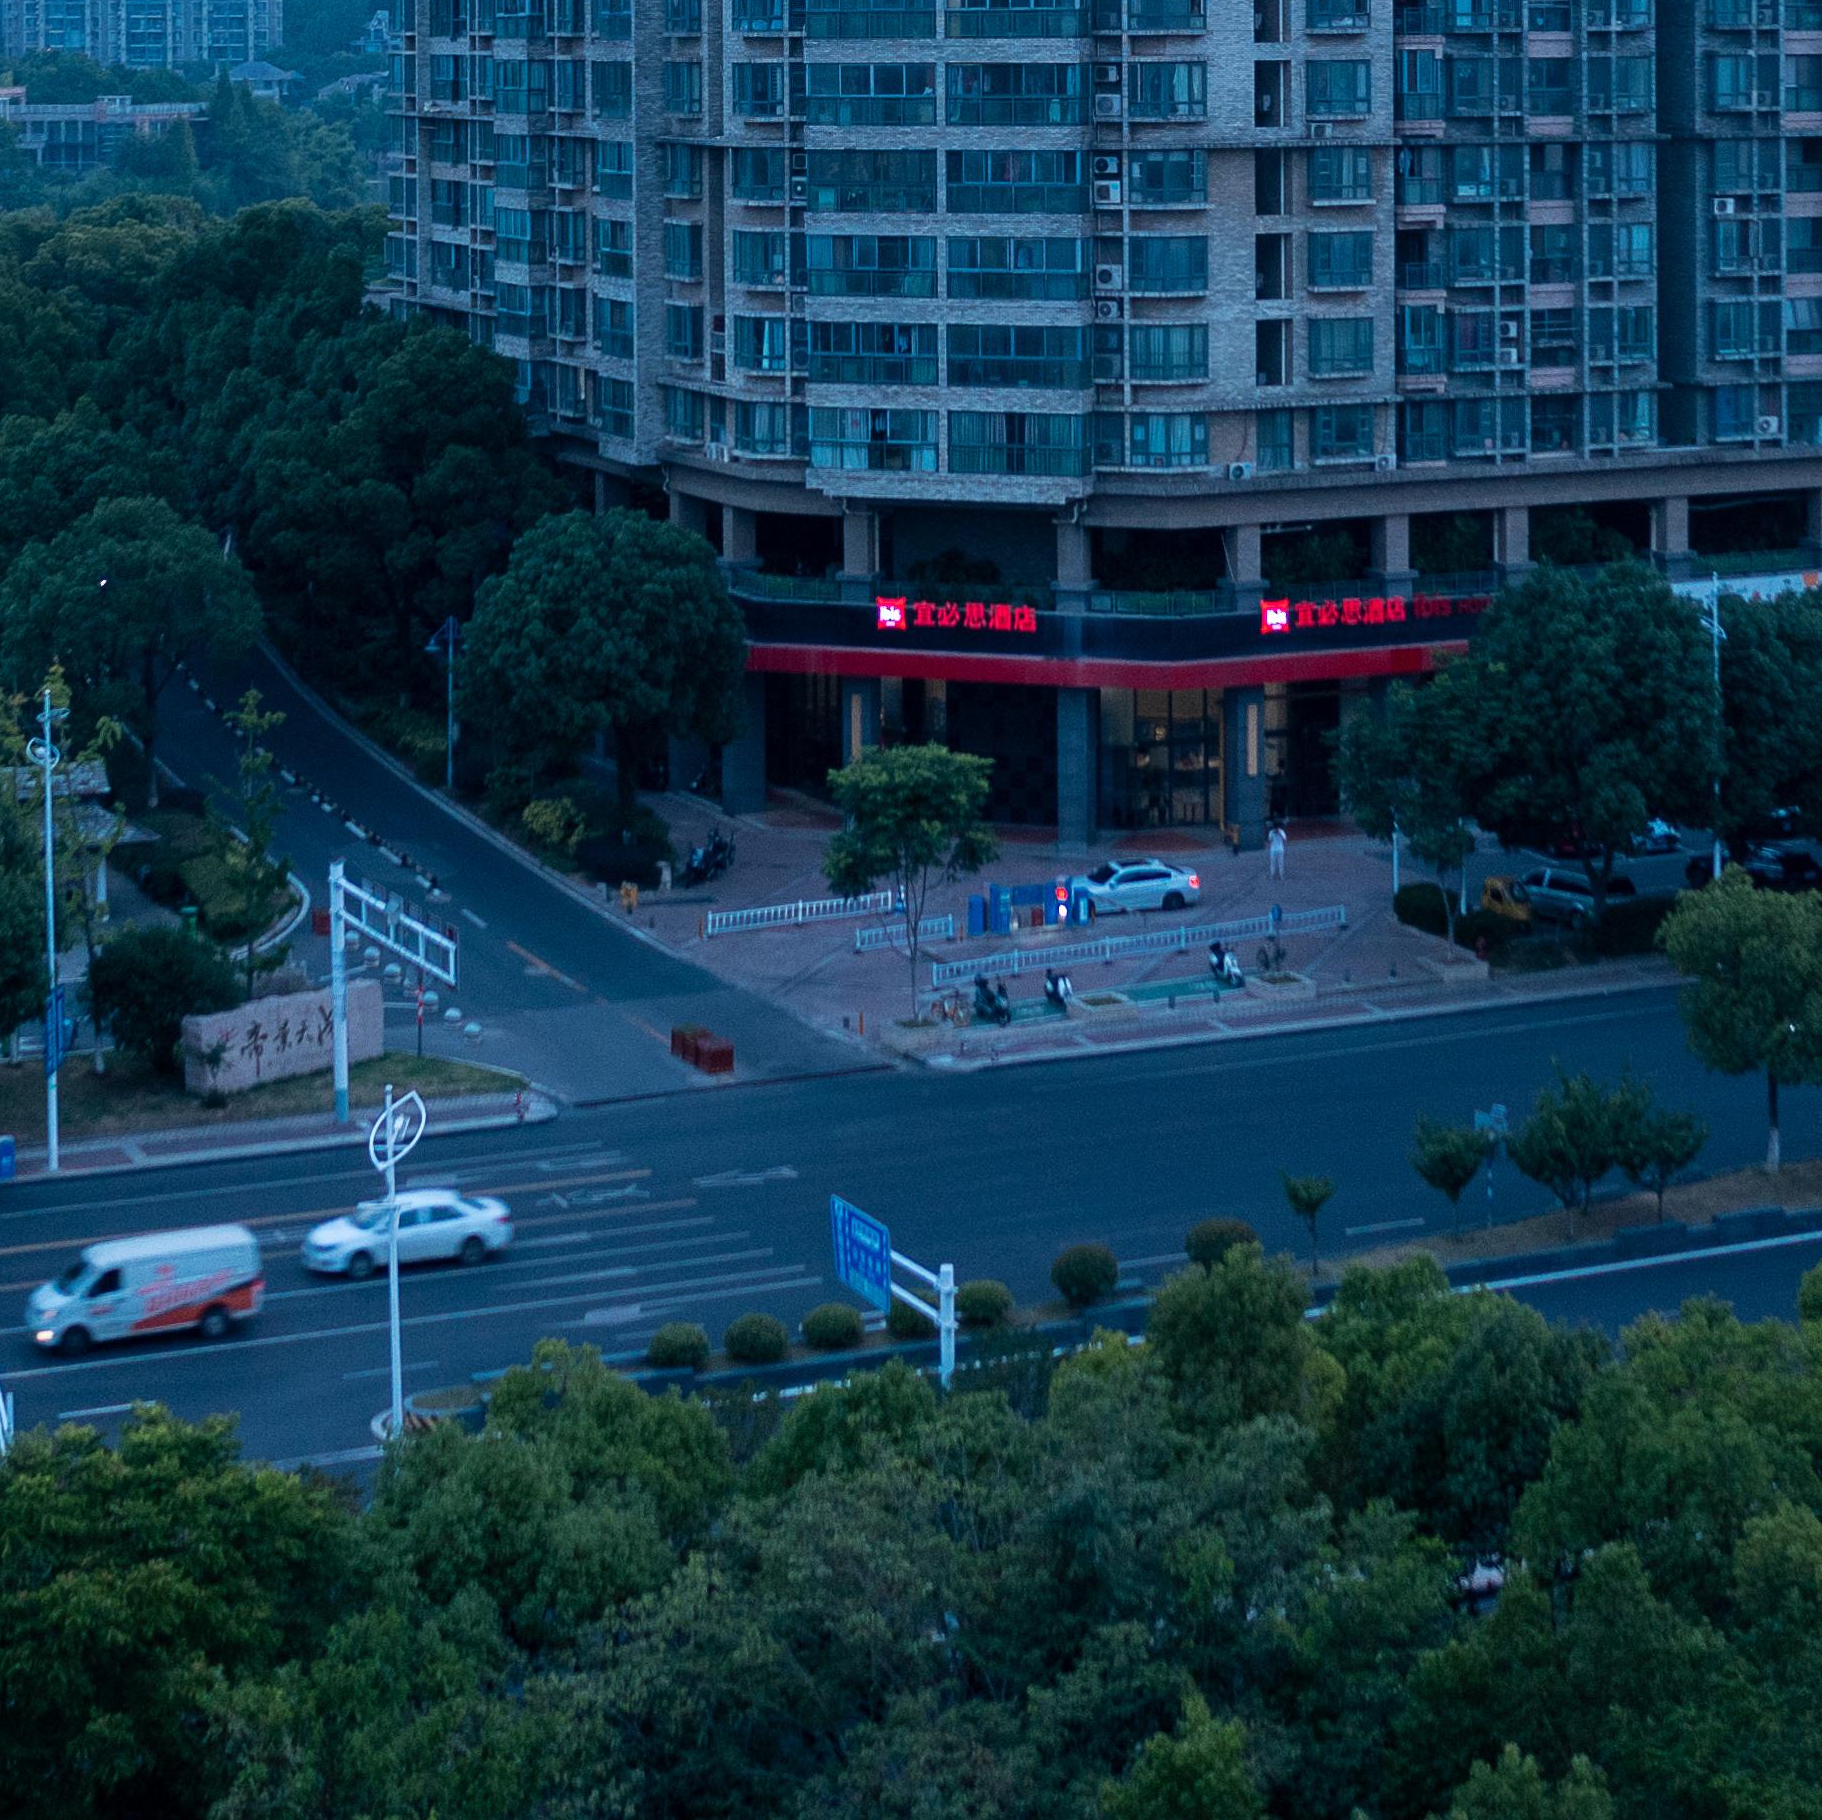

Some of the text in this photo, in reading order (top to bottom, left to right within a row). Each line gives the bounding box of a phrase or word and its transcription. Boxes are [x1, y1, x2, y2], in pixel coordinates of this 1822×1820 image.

[913, 600, 1037, 633] 宜必思酒店
[1294, 595, 1407, 627] 宜必思酒店
